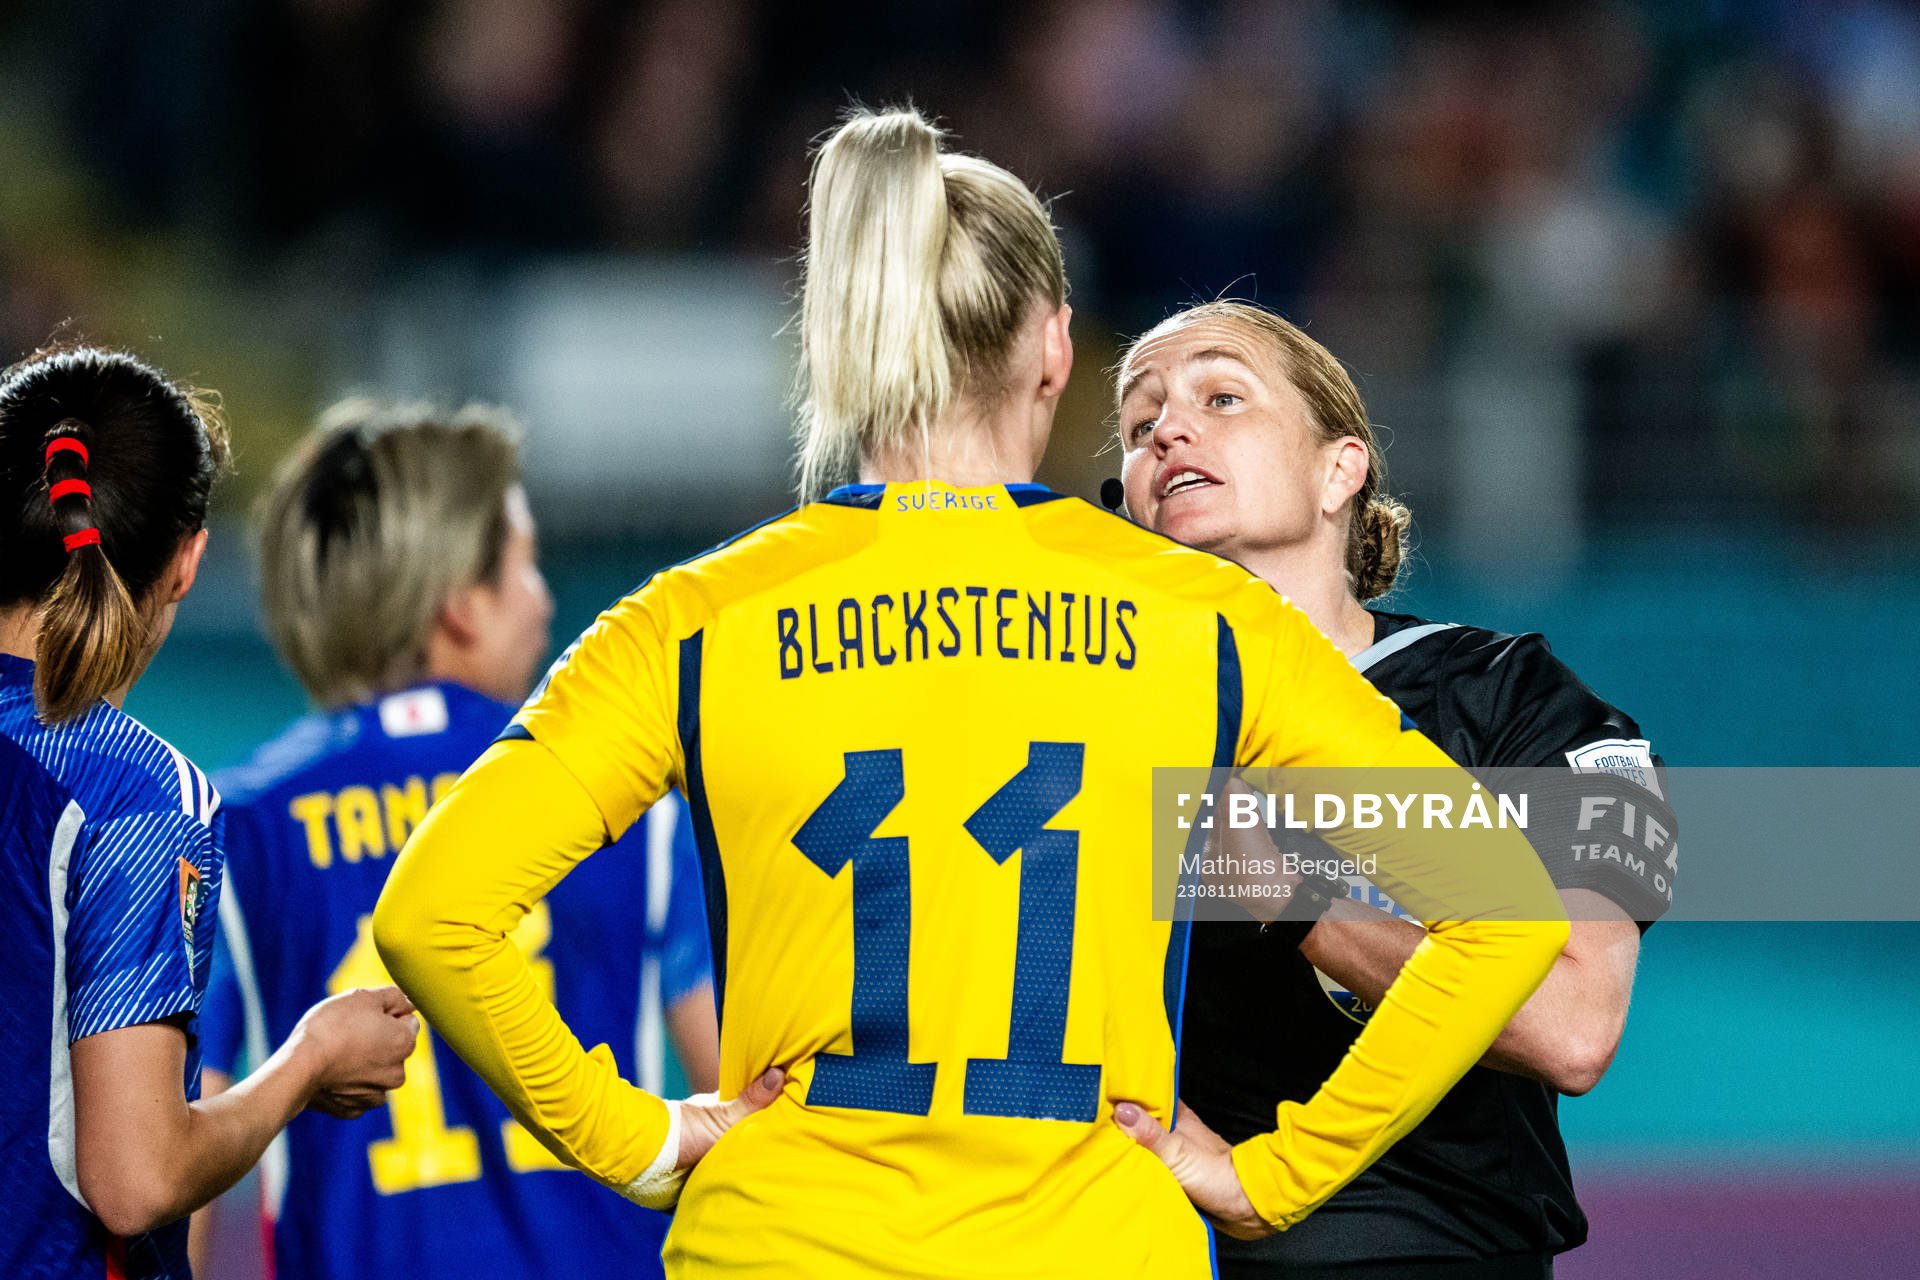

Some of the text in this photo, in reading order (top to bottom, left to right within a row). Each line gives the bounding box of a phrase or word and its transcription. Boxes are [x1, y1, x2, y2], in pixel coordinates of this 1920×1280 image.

[897, 492, 999, 512] SVERIGE
[777, 586, 1137, 680] BLACKSTENIUS
[1595, 755, 1642, 769] FOOTBALL
[1571, 843, 1646, 877] TEAM
[790, 741, 1102, 1123] 11
